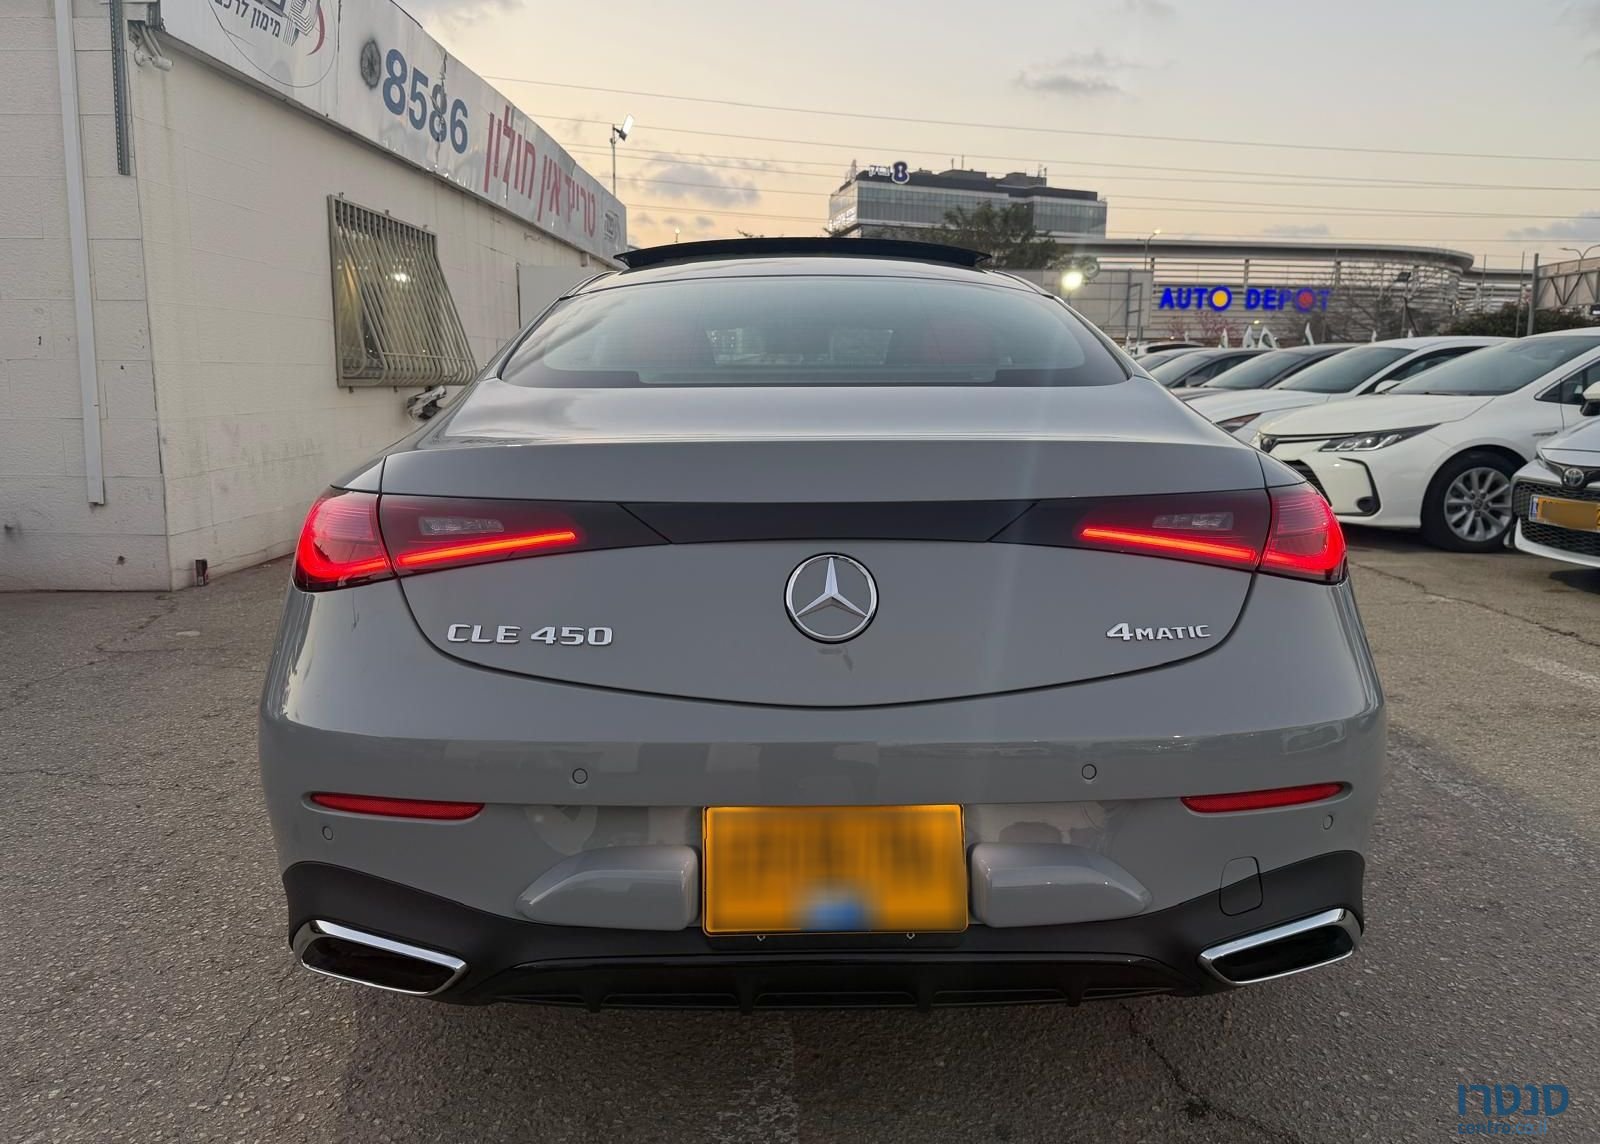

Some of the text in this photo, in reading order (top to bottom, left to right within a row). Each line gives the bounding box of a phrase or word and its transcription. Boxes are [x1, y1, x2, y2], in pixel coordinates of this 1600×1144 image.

[250, 7, 281, 38] מימון
[383, 48, 468, 154] 8586
[484, 105, 536, 200] חולון
[536, 154, 561, 222] אין
[1158, 285, 1331, 313] AUTO DEPOT
[447, 623, 614, 646] CLE 450
[1106, 622, 1211, 641] 4MATIC
